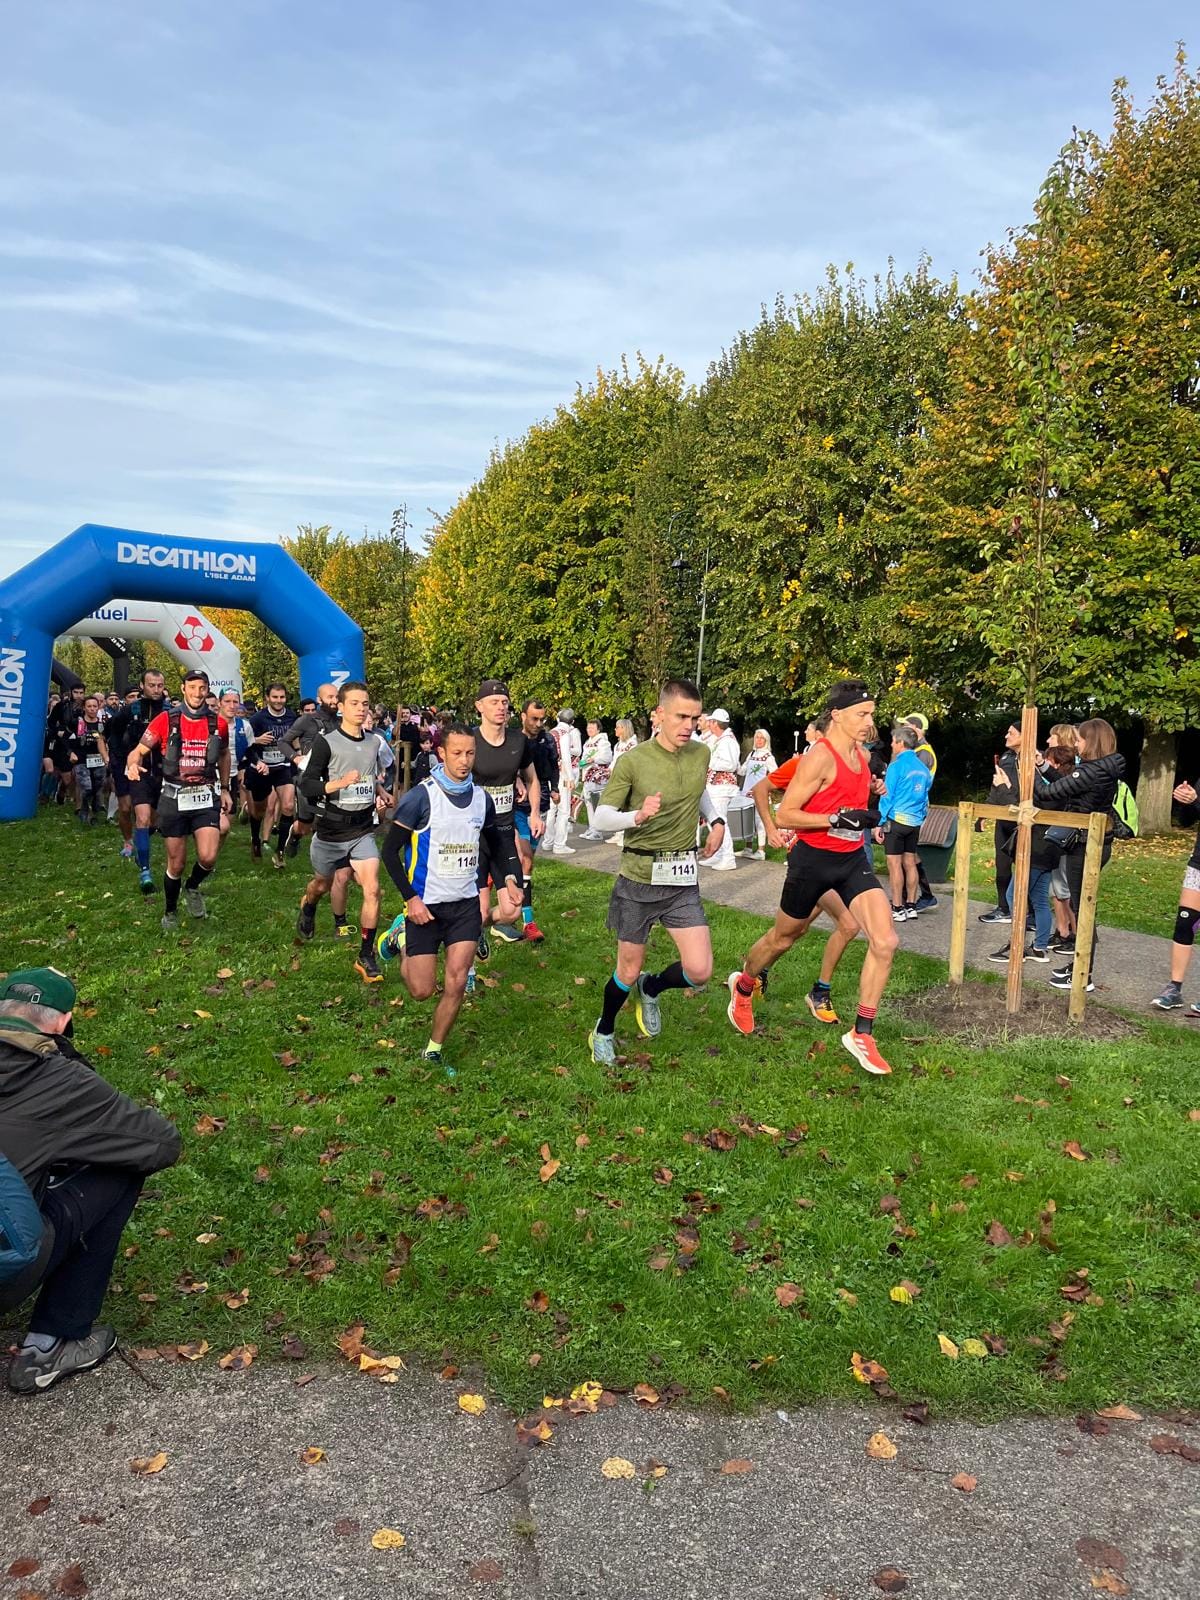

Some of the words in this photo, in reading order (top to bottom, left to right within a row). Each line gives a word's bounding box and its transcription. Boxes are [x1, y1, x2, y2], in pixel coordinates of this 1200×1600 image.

[117, 542, 256, 575] DECATHLON
[204, 572, 228, 580] L'ISLE
[231, 574, 256, 582] ADAM
[355, 786, 373, 795] 1064
[192, 794, 210, 802] 1137
[495, 795, 513, 805] 1136
[457, 856, 477, 867] 1140
[671, 864, 695, 876] 1141
